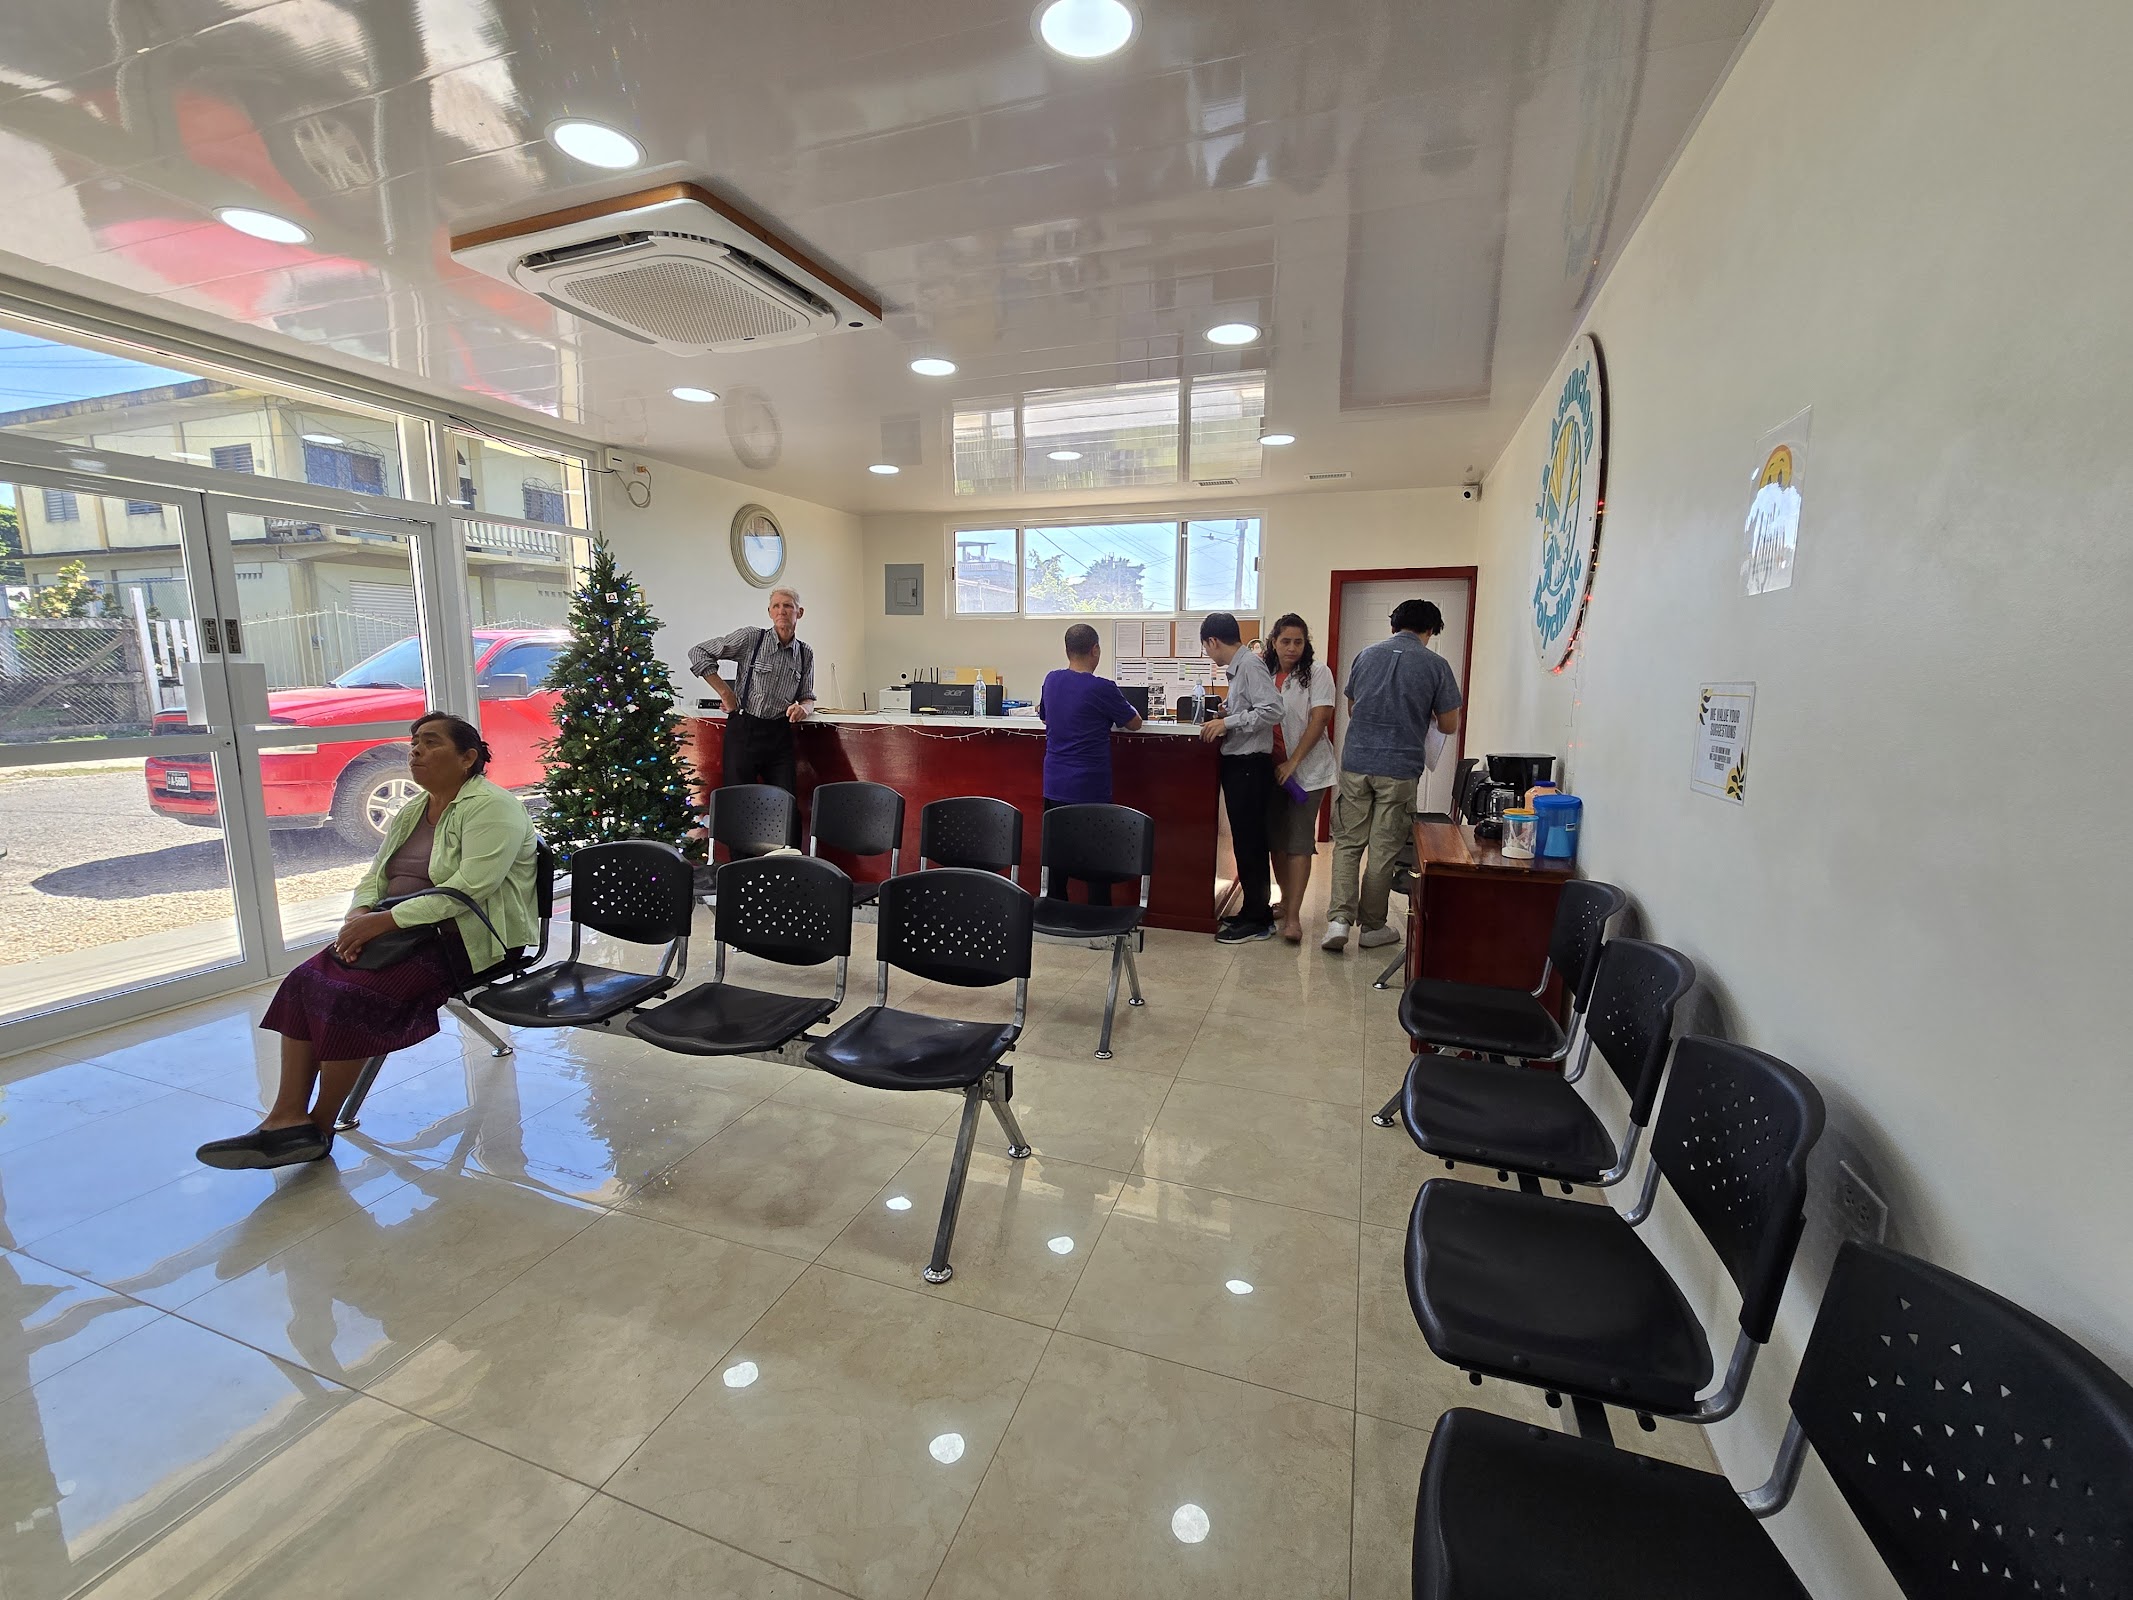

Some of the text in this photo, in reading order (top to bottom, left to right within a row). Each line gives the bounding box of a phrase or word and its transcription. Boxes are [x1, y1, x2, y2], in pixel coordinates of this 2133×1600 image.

[205, 620, 217, 651] PUSH
[228, 621, 239, 651] PULL
[943, 689, 965, 697] acer
[1710, 708, 1740, 723] WE VALUE YOUR
[1710, 723, 1736, 739] SUGGESTIONS
